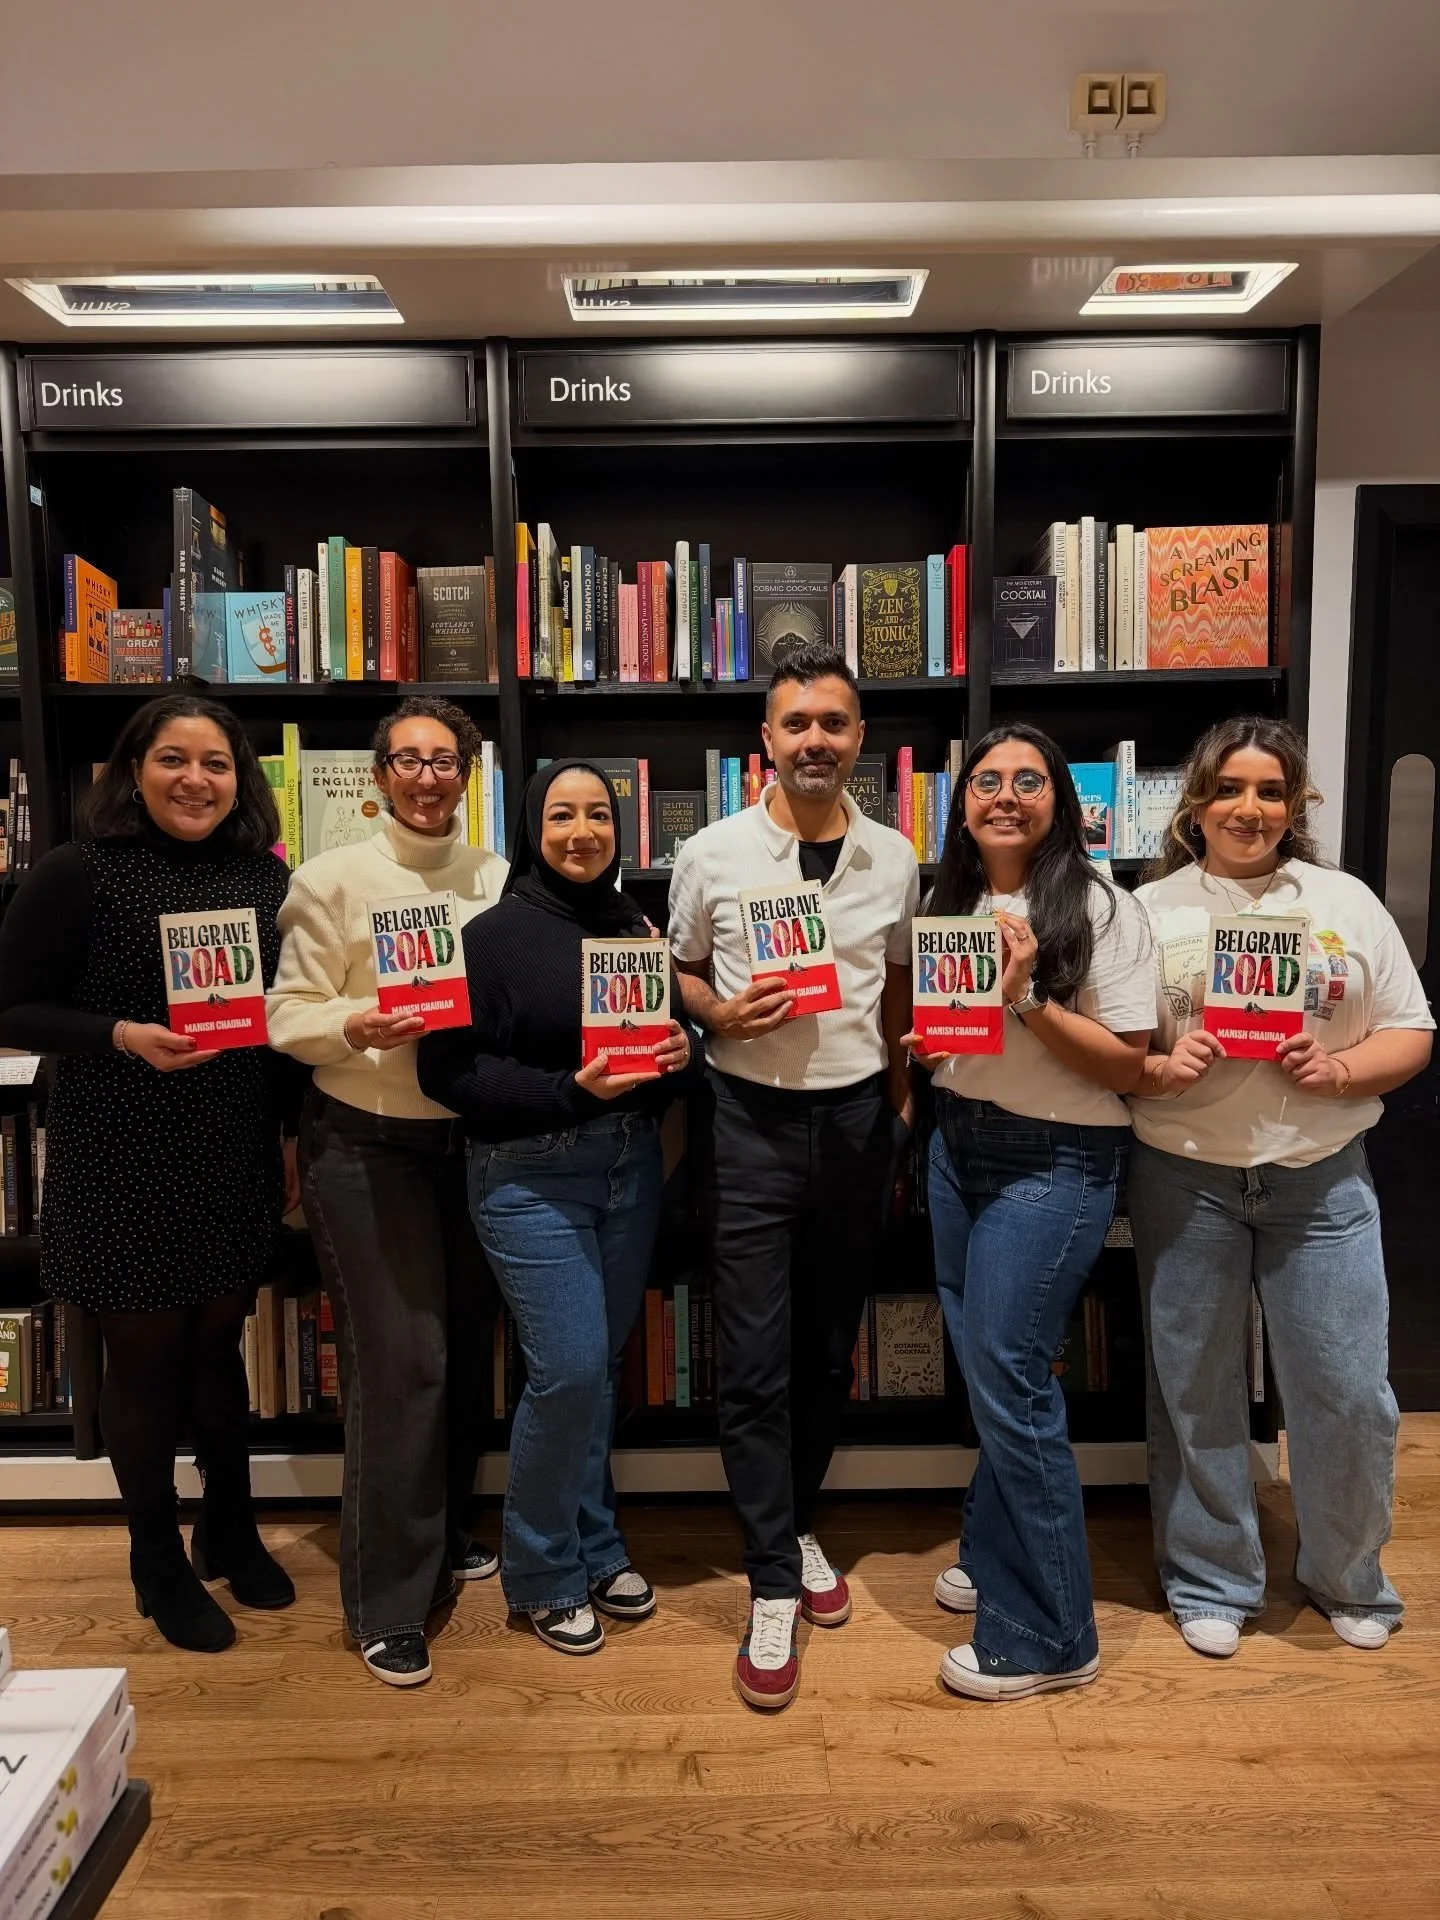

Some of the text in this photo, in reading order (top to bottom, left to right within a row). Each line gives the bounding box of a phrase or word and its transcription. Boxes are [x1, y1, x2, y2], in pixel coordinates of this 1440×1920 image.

[41, 382, 123, 408] Drinks
[549, 376, 631, 402] Drinks
[1031, 369, 1112, 395] Drinks
[1160, 532, 1261, 587] SCREAMING
[1170, 546, 1183, 560] A
[1098, 562, 1105, 572] AN
[85, 577, 111, 598] WHISKY
[433, 586, 470, 601] SCOTCH
[584, 563, 592, 632] ON CHAMPAGNE
[1000, 589, 1047, 601] COCKTAIL
[1170, 558, 1257, 612] BLAST
[234, 597, 285, 619] WHISKY
[351, 565, 360, 658] WHISKEY AMERICA
[562, 580, 570, 620] Champagne
[680, 574, 688, 624] CALIFORNIA
[878, 598, 905, 615] ZEN
[435, 627, 470, 635] WHISKIES
[883, 615, 899, 624] AND
[127, 639, 159, 648] GREAT
[641, 618, 649, 666] LANGUEDOC
[871, 625, 912, 641] TONIC
[313, 766, 327, 774] OZ
[313, 777, 376, 786] ENGLISH
[326, 789, 364, 798] WINE
[1126, 745, 1134, 823] MIND YOUR MANNERS
[663, 823, 694, 832] LOVERS
[372, 904, 452, 933] BELGRAVE
[749, 893, 821, 922] BELGRAVE
[166, 922, 252, 949] BELGRAVE
[752, 915, 826, 961] ROAD
[917, 932, 996, 954] BELGRAVE
[1165, 938, 1202, 950] PAKISTAN
[1214, 929, 1301, 956] BELGRAVE
[374, 927, 455, 974] ROAD
[589, 952, 664, 974] BELGRAVE
[169, 945, 255, 991] ROAD
[918, 954, 997, 994] ROAD
[1212, 952, 1301, 998] ROAD
[589, 974, 665, 1014] ROAD
[1174, 995, 1190, 1009] 20
[6, 1136, 15, 1206] RUM REVOLUTION
